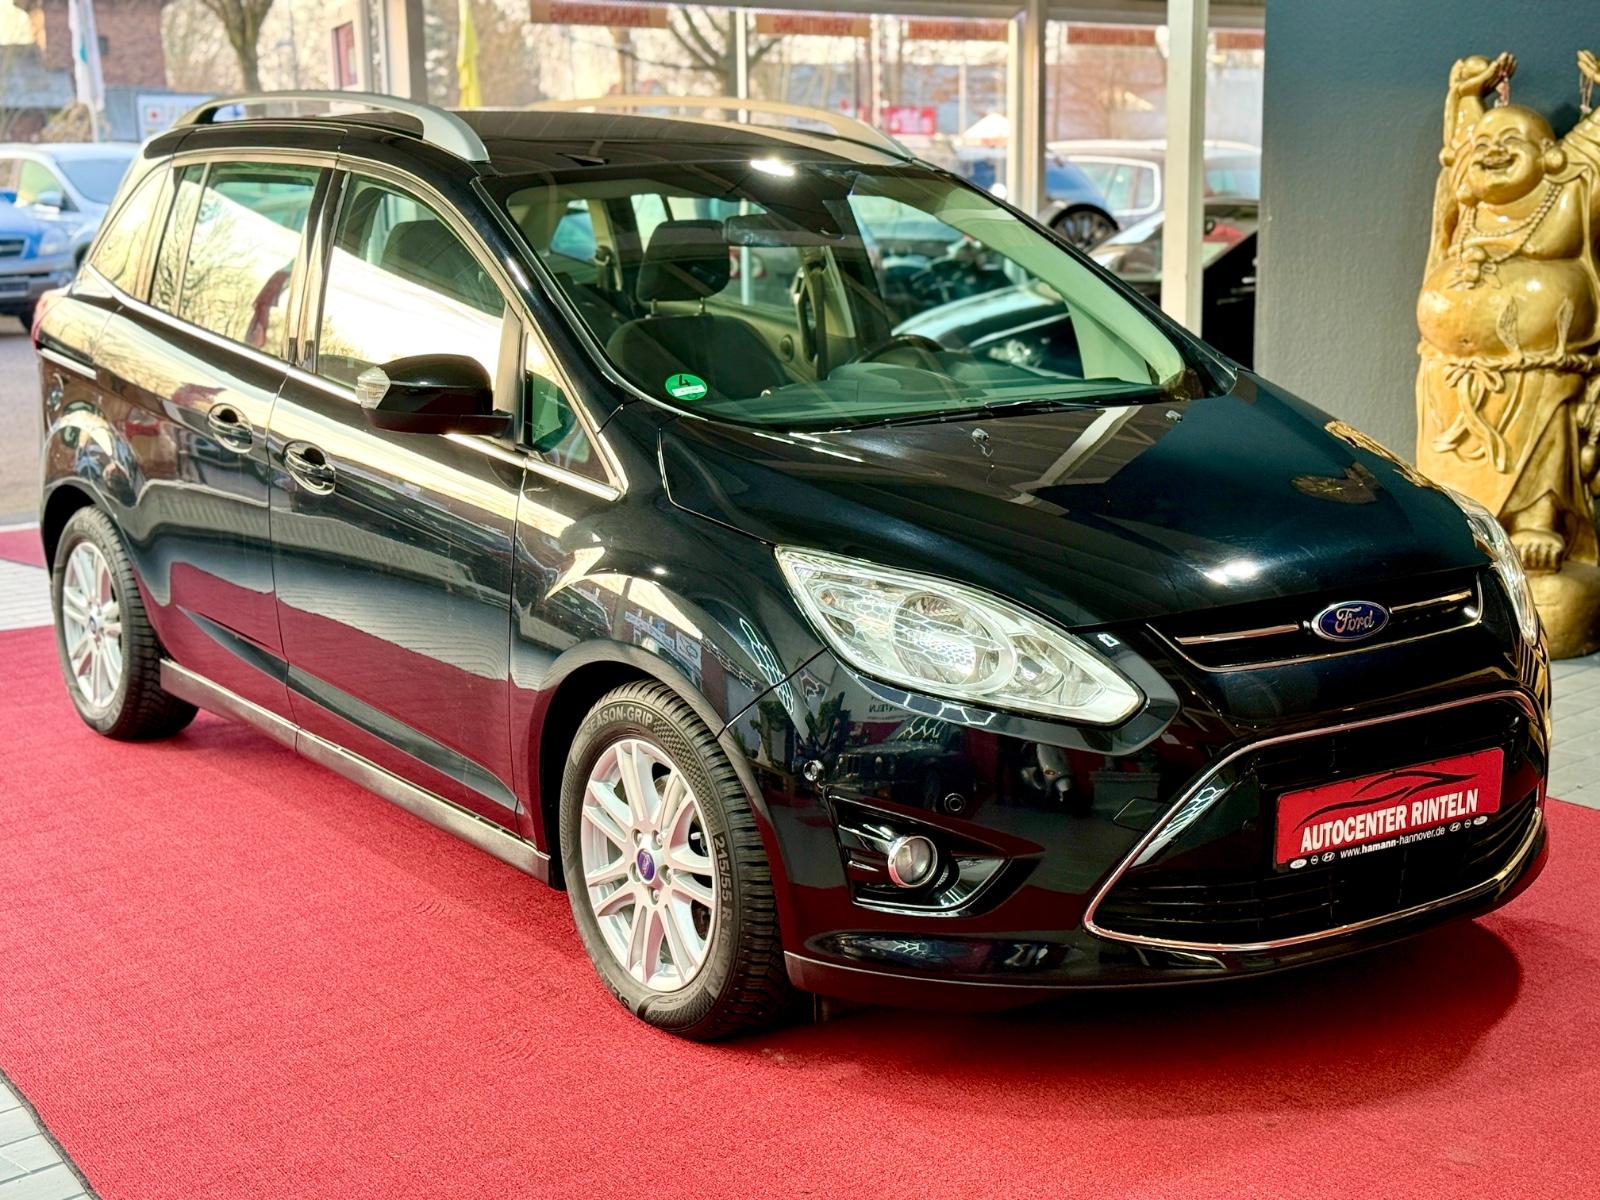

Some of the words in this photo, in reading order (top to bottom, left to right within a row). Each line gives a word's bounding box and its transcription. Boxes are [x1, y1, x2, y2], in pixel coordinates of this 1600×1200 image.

[1335, 606, 1375, 633] Ford
[1301, 805, 1407, 853] AUTOCENTER
[1411, 788, 1478, 827] RINTELN
[1340, 826, 1446, 859] www.hamann-hannover.de
[714, 835, 732, 901] 215/55
